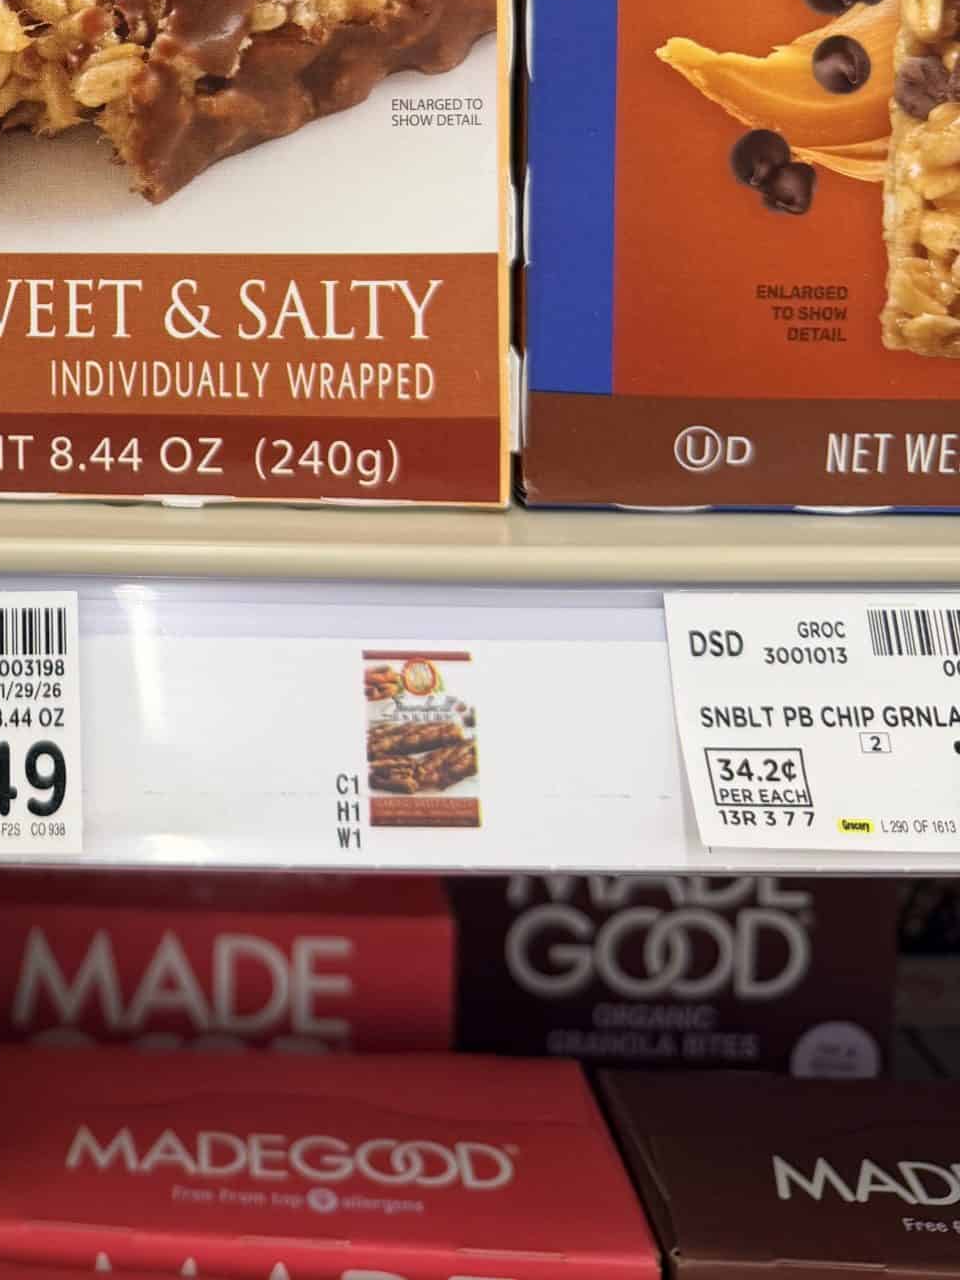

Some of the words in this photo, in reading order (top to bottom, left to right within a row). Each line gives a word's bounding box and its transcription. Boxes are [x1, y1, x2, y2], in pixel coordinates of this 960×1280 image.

[392, 98, 462, 111] ENLARGED
[466, 98, 483, 110] TO
[392, 114, 432, 127] SHOW
[437, 113, 481, 126] DETAIL
[756, 285, 848, 301] ENLARGED
[164, 279, 220, 339] &
[238, 279, 443, 340] SALTY
[772, 306, 793, 321] TO
[799, 306, 848, 321] SHOW
[787, 327, 847, 342] DETAIL
[50, 359, 269, 398] INDIVIDUALLY
[286, 361, 435, 400] WRAPPED
[49, 435, 143, 472] 8.44
[159, 436, 224, 474] OZ
[254, 438, 401, 486] (240g)
[825, 433, 896, 474] NET
[797, 622, 846, 639] GROC
[689, 630, 744, 657] DSD
[764, 647, 848, 664] 3001013
[38, 707, 65, 727] OZ
[700, 706, 775, 728] SNBLT
[783, 706, 814, 728] PB
[820, 706, 875, 728] CHIP
[870, 736, 882, 751] 2
[336, 774, 359, 794] C1
[720, 789, 754, 802] PER
[760, 789, 808, 803] EACH
[337, 801, 360, 821] H1
[719, 810, 757, 826] 13R
[764, 811, 777, 826] 3
[784, 811, 796, 826] 7
[803, 811, 815, 827] 7
[48, 823, 66, 836] 938
[890, 820, 909, 833] 290
[913, 820, 929, 833] OF
[932, 820, 957, 833] 1613
[337, 828, 361, 848] W1
[505, 903, 811, 998] GOOD
[12, 925, 353, 1038] MADE
[65, 1125, 514, 1191] MADEGOOD
